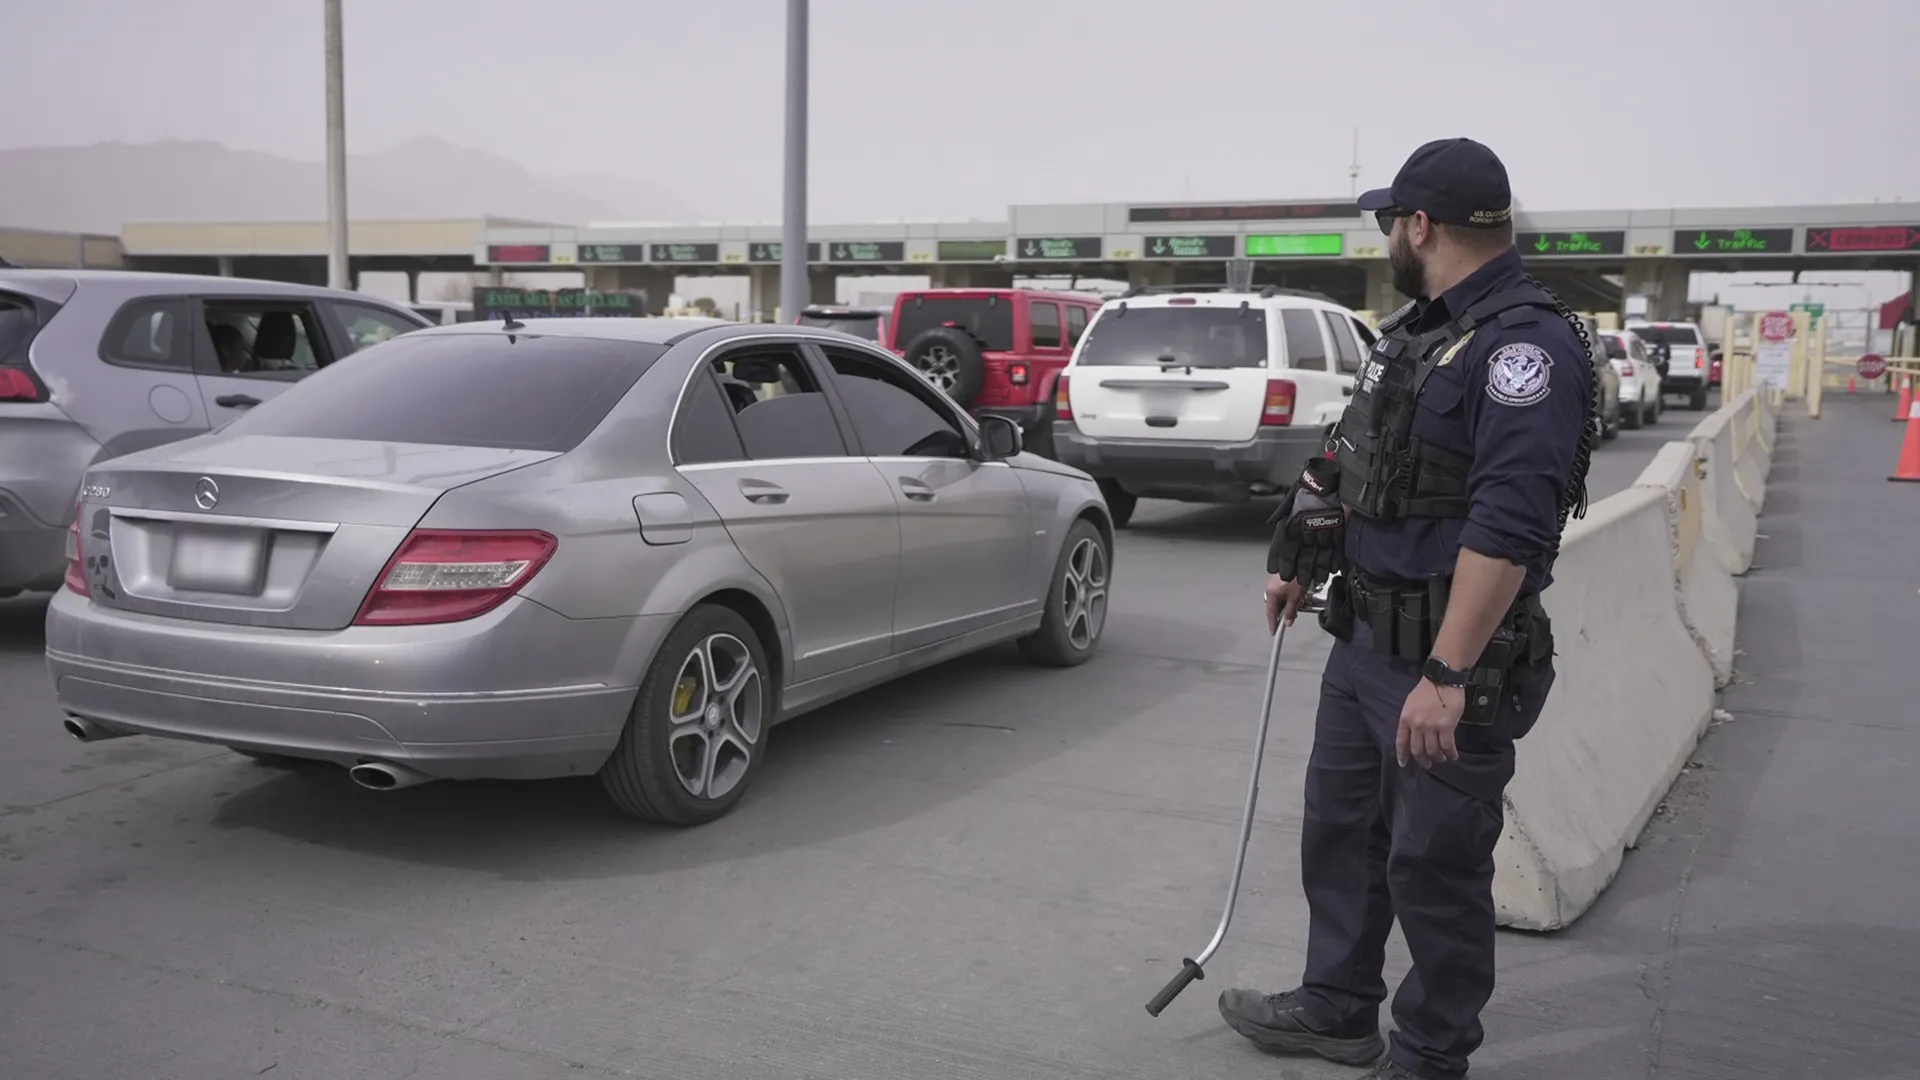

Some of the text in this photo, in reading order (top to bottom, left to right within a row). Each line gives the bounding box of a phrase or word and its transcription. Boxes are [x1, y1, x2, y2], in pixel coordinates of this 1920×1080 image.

[1556, 240, 1602, 252] Traffic
[1717, 239, 1767, 250] Traffic
[524, 293, 574, 307] MULAS
[1764, 315, 1790, 326] STOP
[1763, 326, 1790, 338] ALTO
[1859, 360, 1887, 372] STOP
